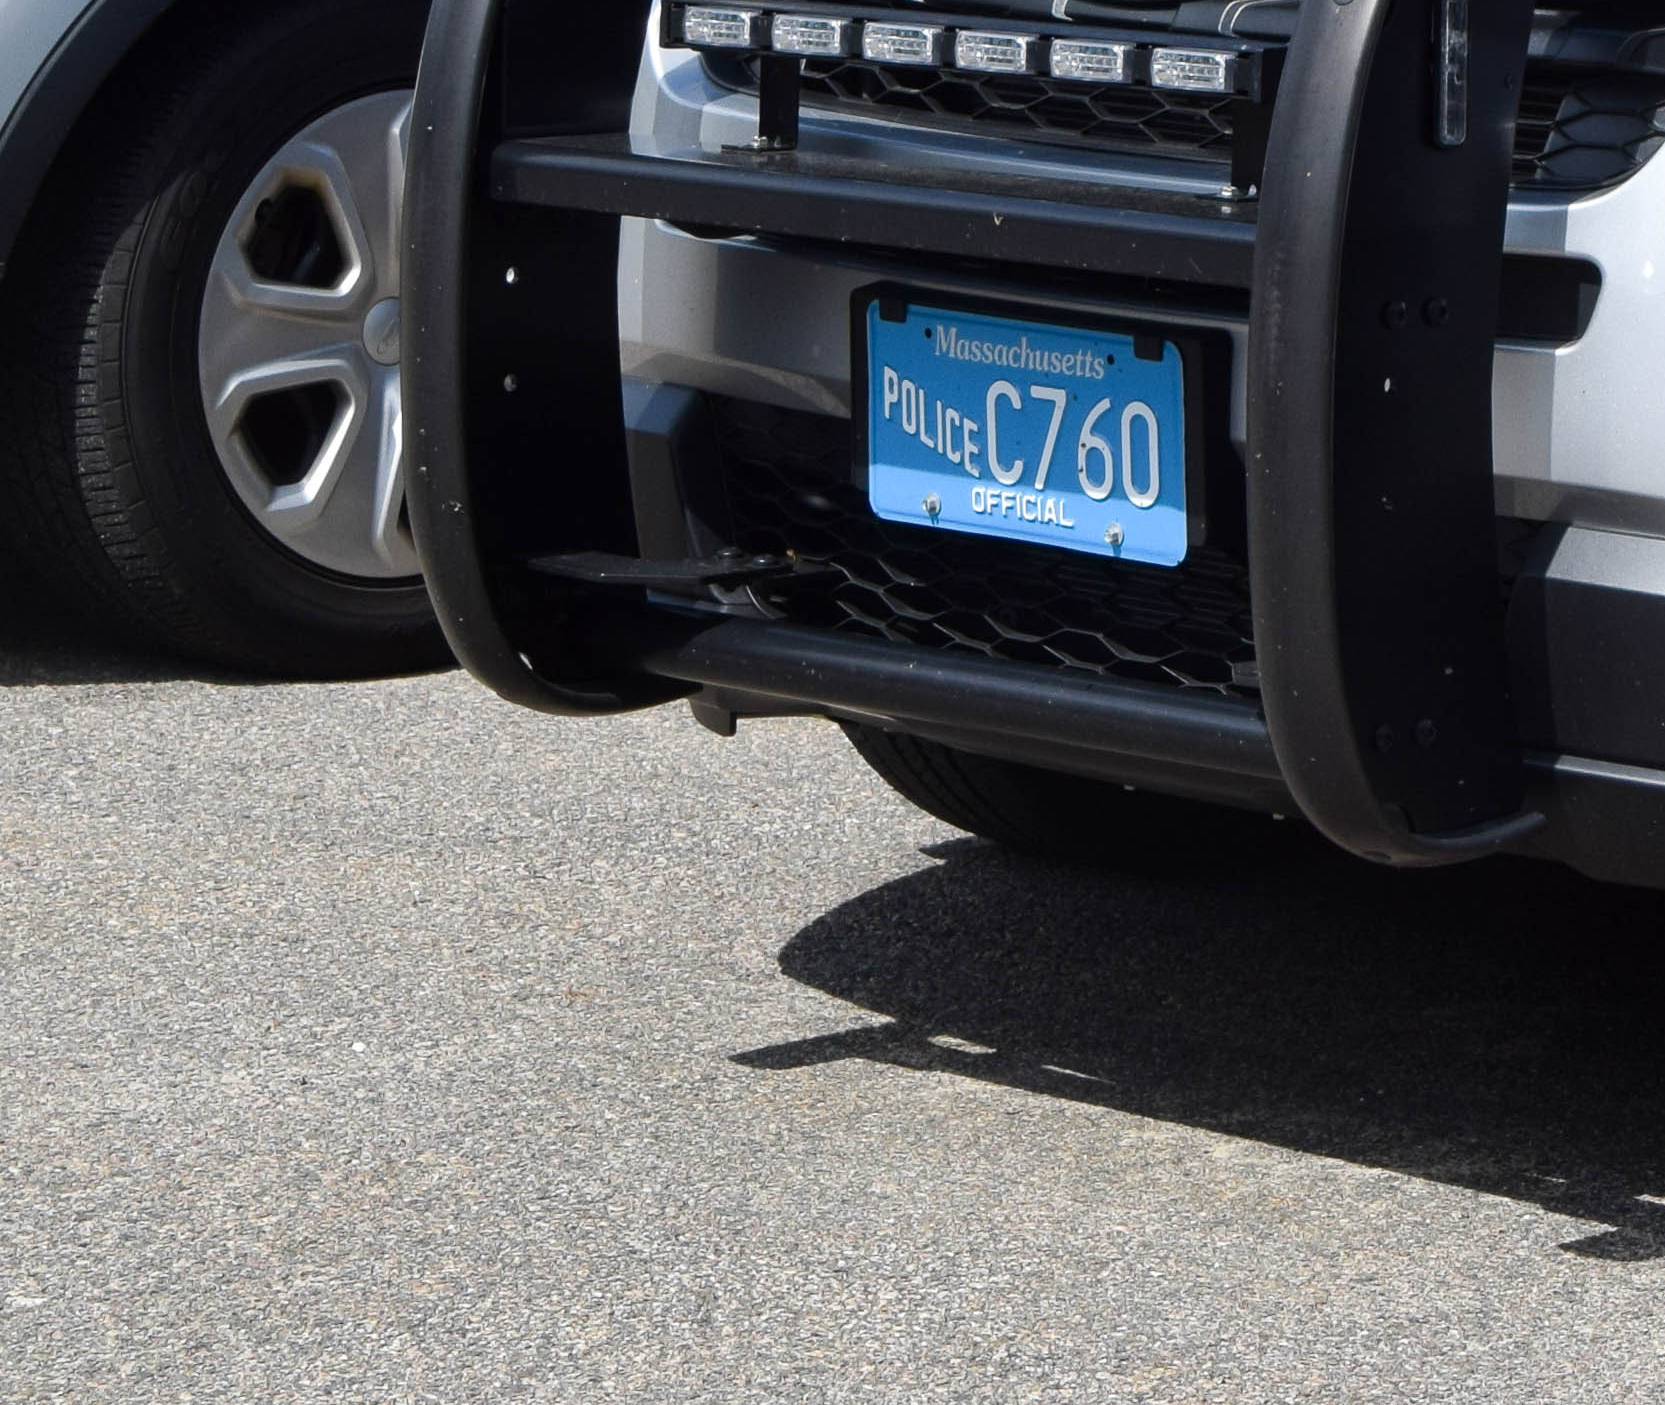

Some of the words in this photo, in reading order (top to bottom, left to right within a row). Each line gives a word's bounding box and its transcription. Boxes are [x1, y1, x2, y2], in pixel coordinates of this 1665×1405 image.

[934, 324, 1105, 380] Massachusetts
[883, 365, 981, 479] POLICE
[985, 380, 1161, 509] C760
[971, 486, 1075, 528] OFFICIAL
